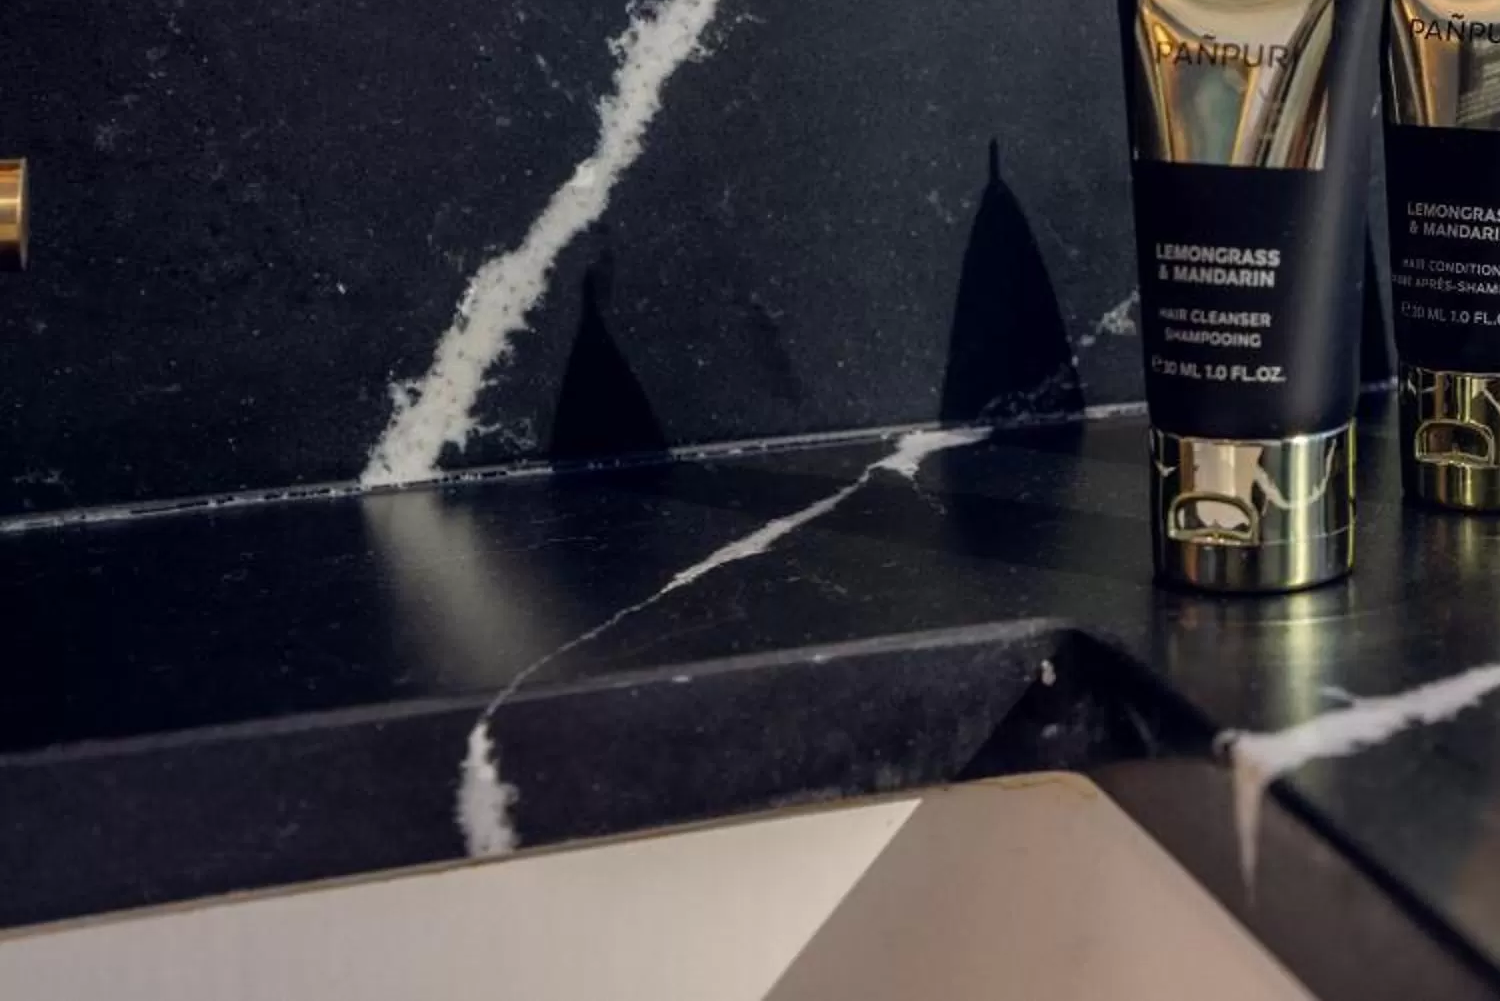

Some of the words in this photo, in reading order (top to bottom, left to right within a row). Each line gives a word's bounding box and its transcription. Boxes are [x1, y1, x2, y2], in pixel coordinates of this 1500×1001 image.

[1156, 32, 1299, 68] PAÑPUR
[1409, 219, 1419, 234] &
[1156, 242, 1281, 268] LEMONGRASS
[1173, 265, 1275, 288] MANDARIN
[1190, 309, 1272, 328] CLEANSER
[1164, 327, 1262, 348] SHAMPOOING
[1180, 361, 1201, 378] ML
